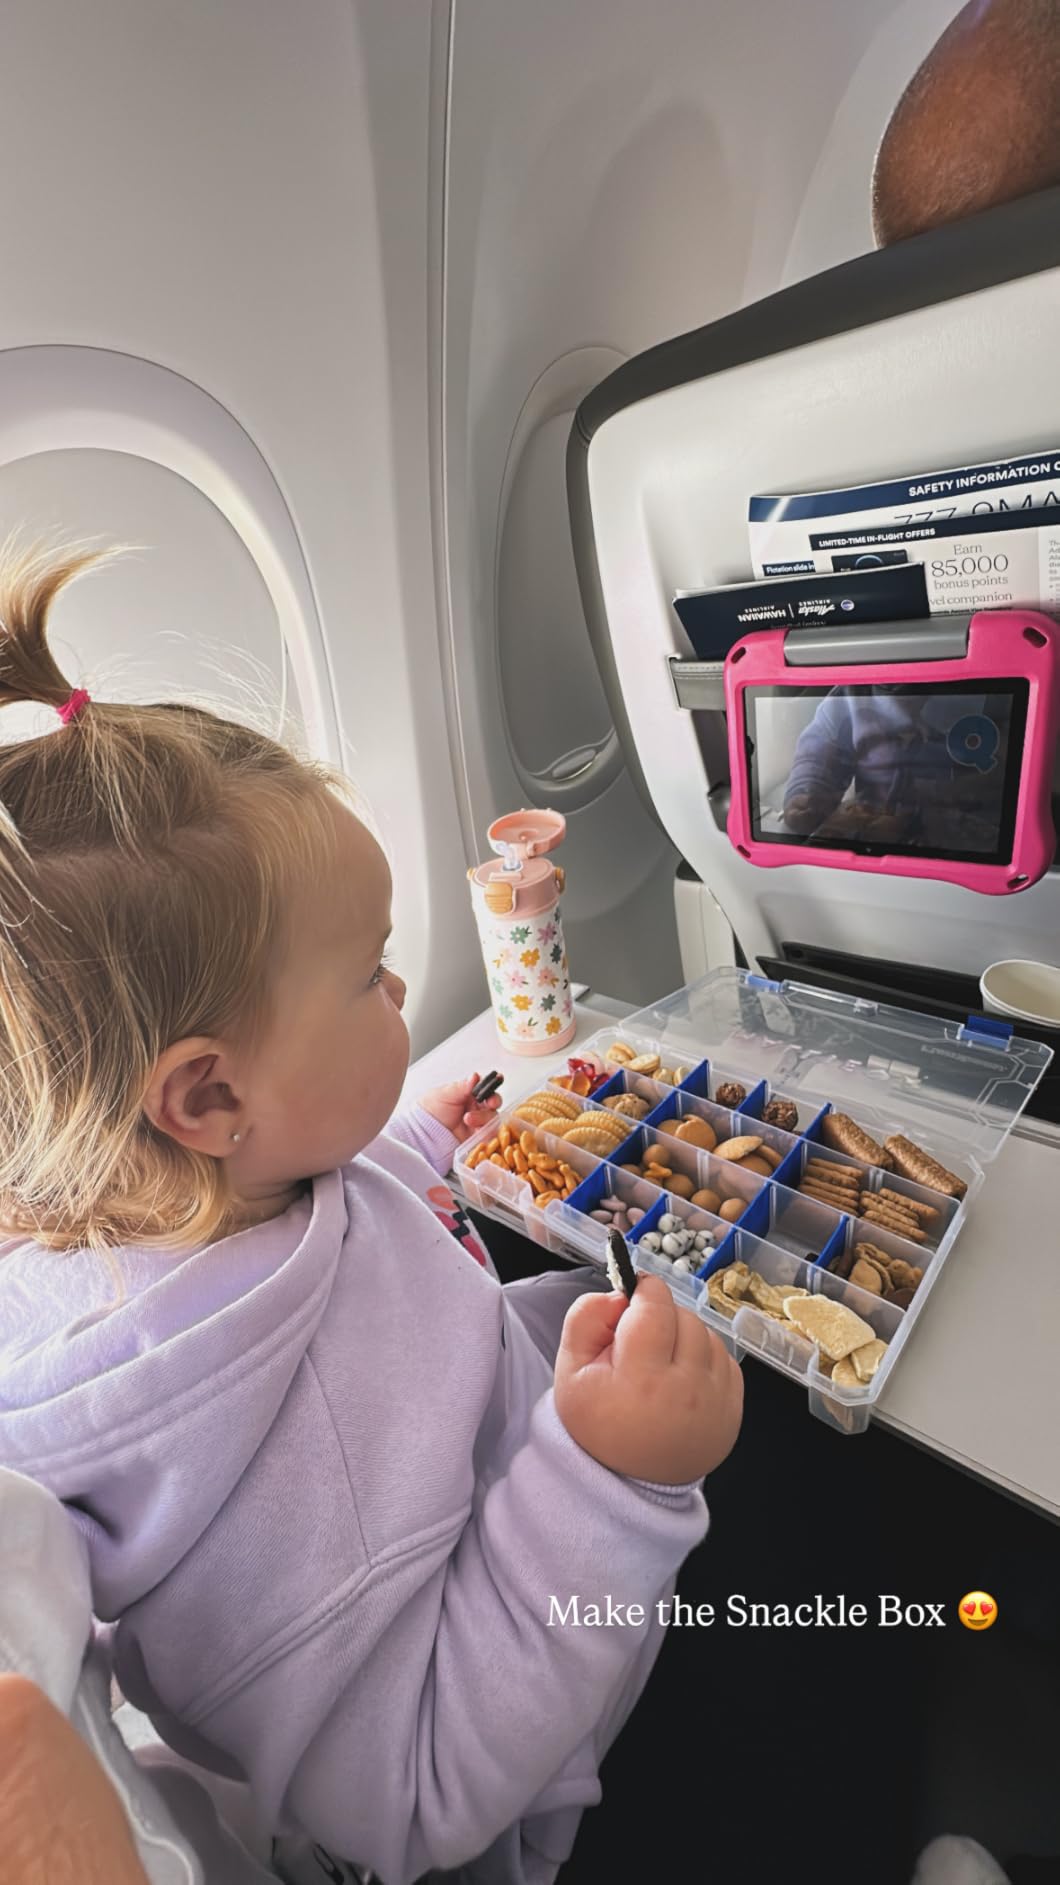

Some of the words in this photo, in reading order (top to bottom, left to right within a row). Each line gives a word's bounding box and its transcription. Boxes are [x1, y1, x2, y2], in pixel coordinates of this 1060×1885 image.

[908, 481, 953, 496] SAFETY
[956, 463, 1050, 488] INFORMATION
[819, 536, 866, 547] LIMITED-TIME
[867, 532, 903, 542] IN-FLIGHT
[905, 528, 936, 539] OFFERS
[953, 544, 982, 555] Earn
[931, 554, 1008, 577] 85,000
[933, 579, 969, 590] bonus
[972, 576, 1008, 589] points
[799, 599, 830, 607] AIRLINES
[929, 595, 945, 606] vel
[947, 591, 1012, 606] companion
[738, 609, 786, 622] HAWAIIAN
[745, 605, 775, 613] AIRLINES
[798, 604, 835, 616] Alaska
